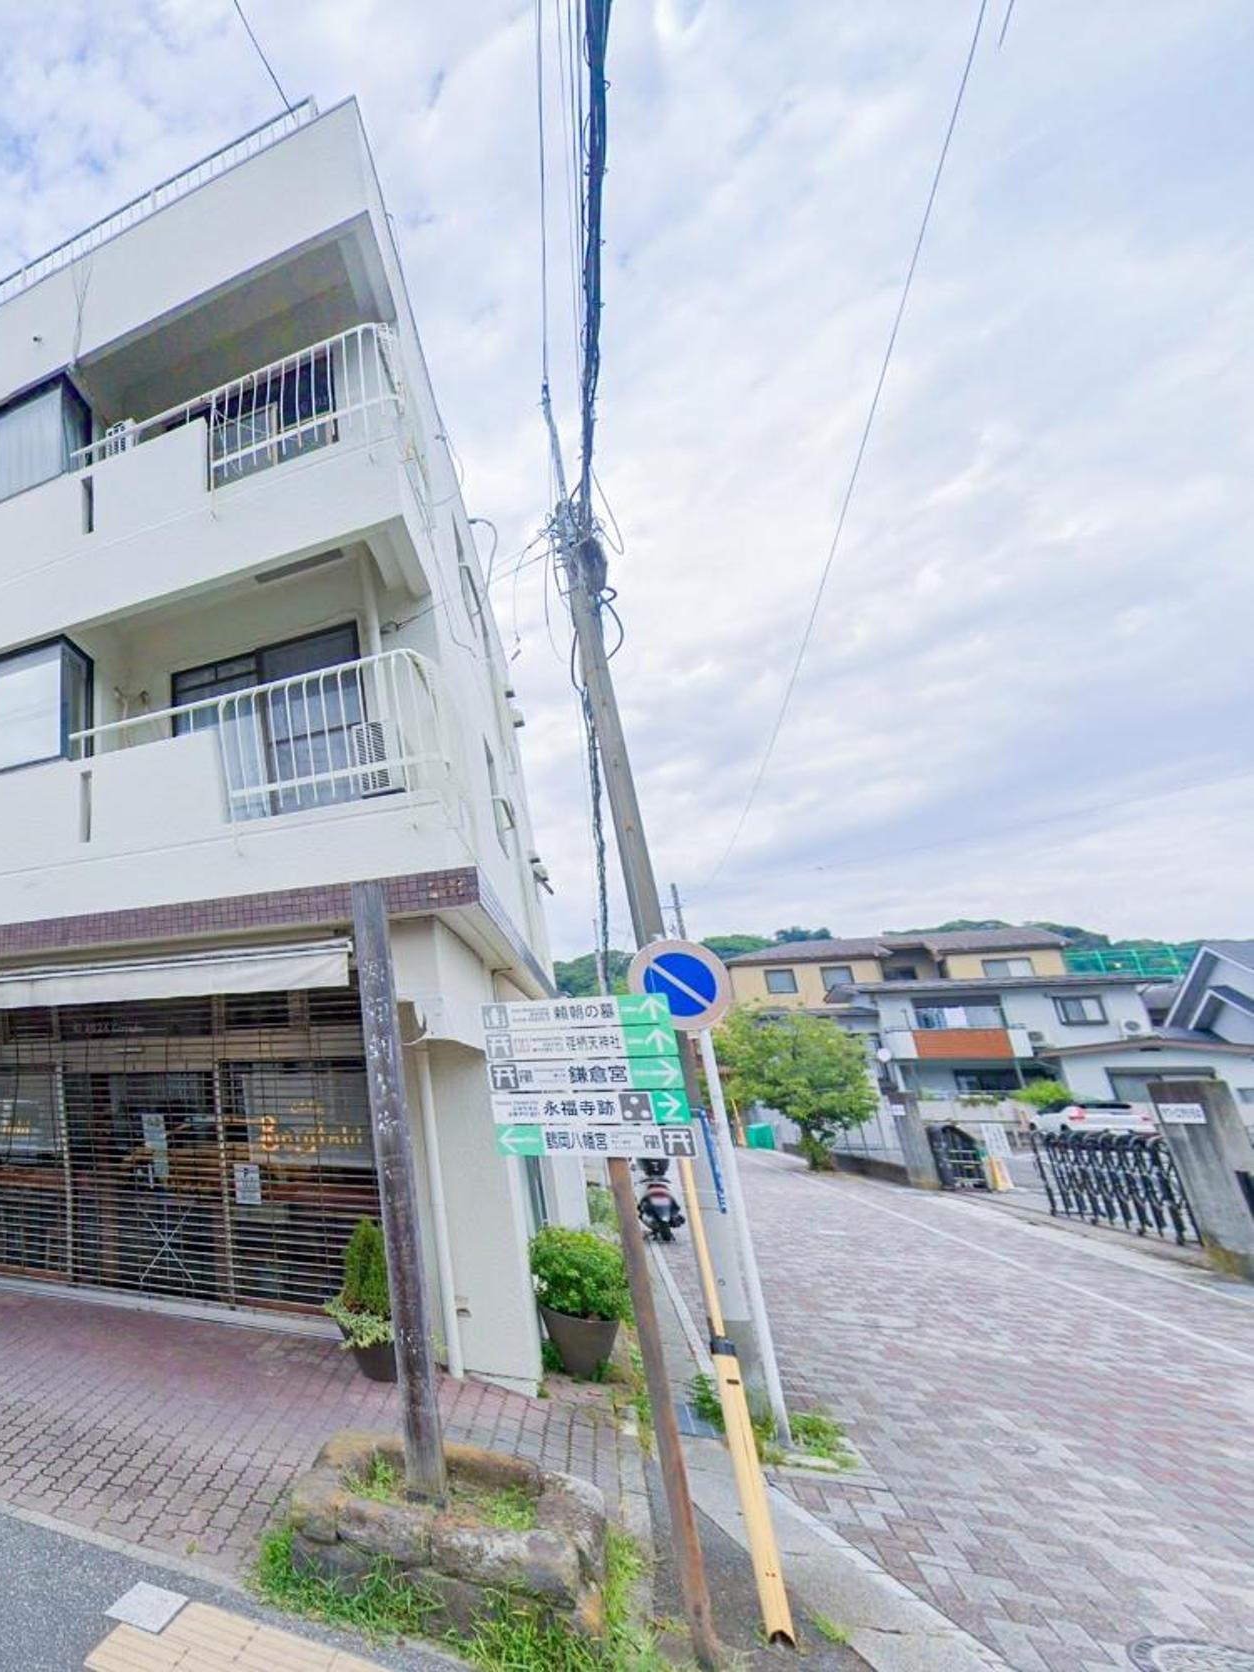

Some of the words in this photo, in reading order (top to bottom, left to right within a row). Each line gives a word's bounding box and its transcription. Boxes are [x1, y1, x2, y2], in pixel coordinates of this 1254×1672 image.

[554, 1002, 615, 1020] 頼朝の墓
[568, 1065, 629, 1084] 鎌倉宮
[543, 1100, 616, 1117] 永福寺跡
[545, 1131, 609, 1151] 鶴岡八幡宮
